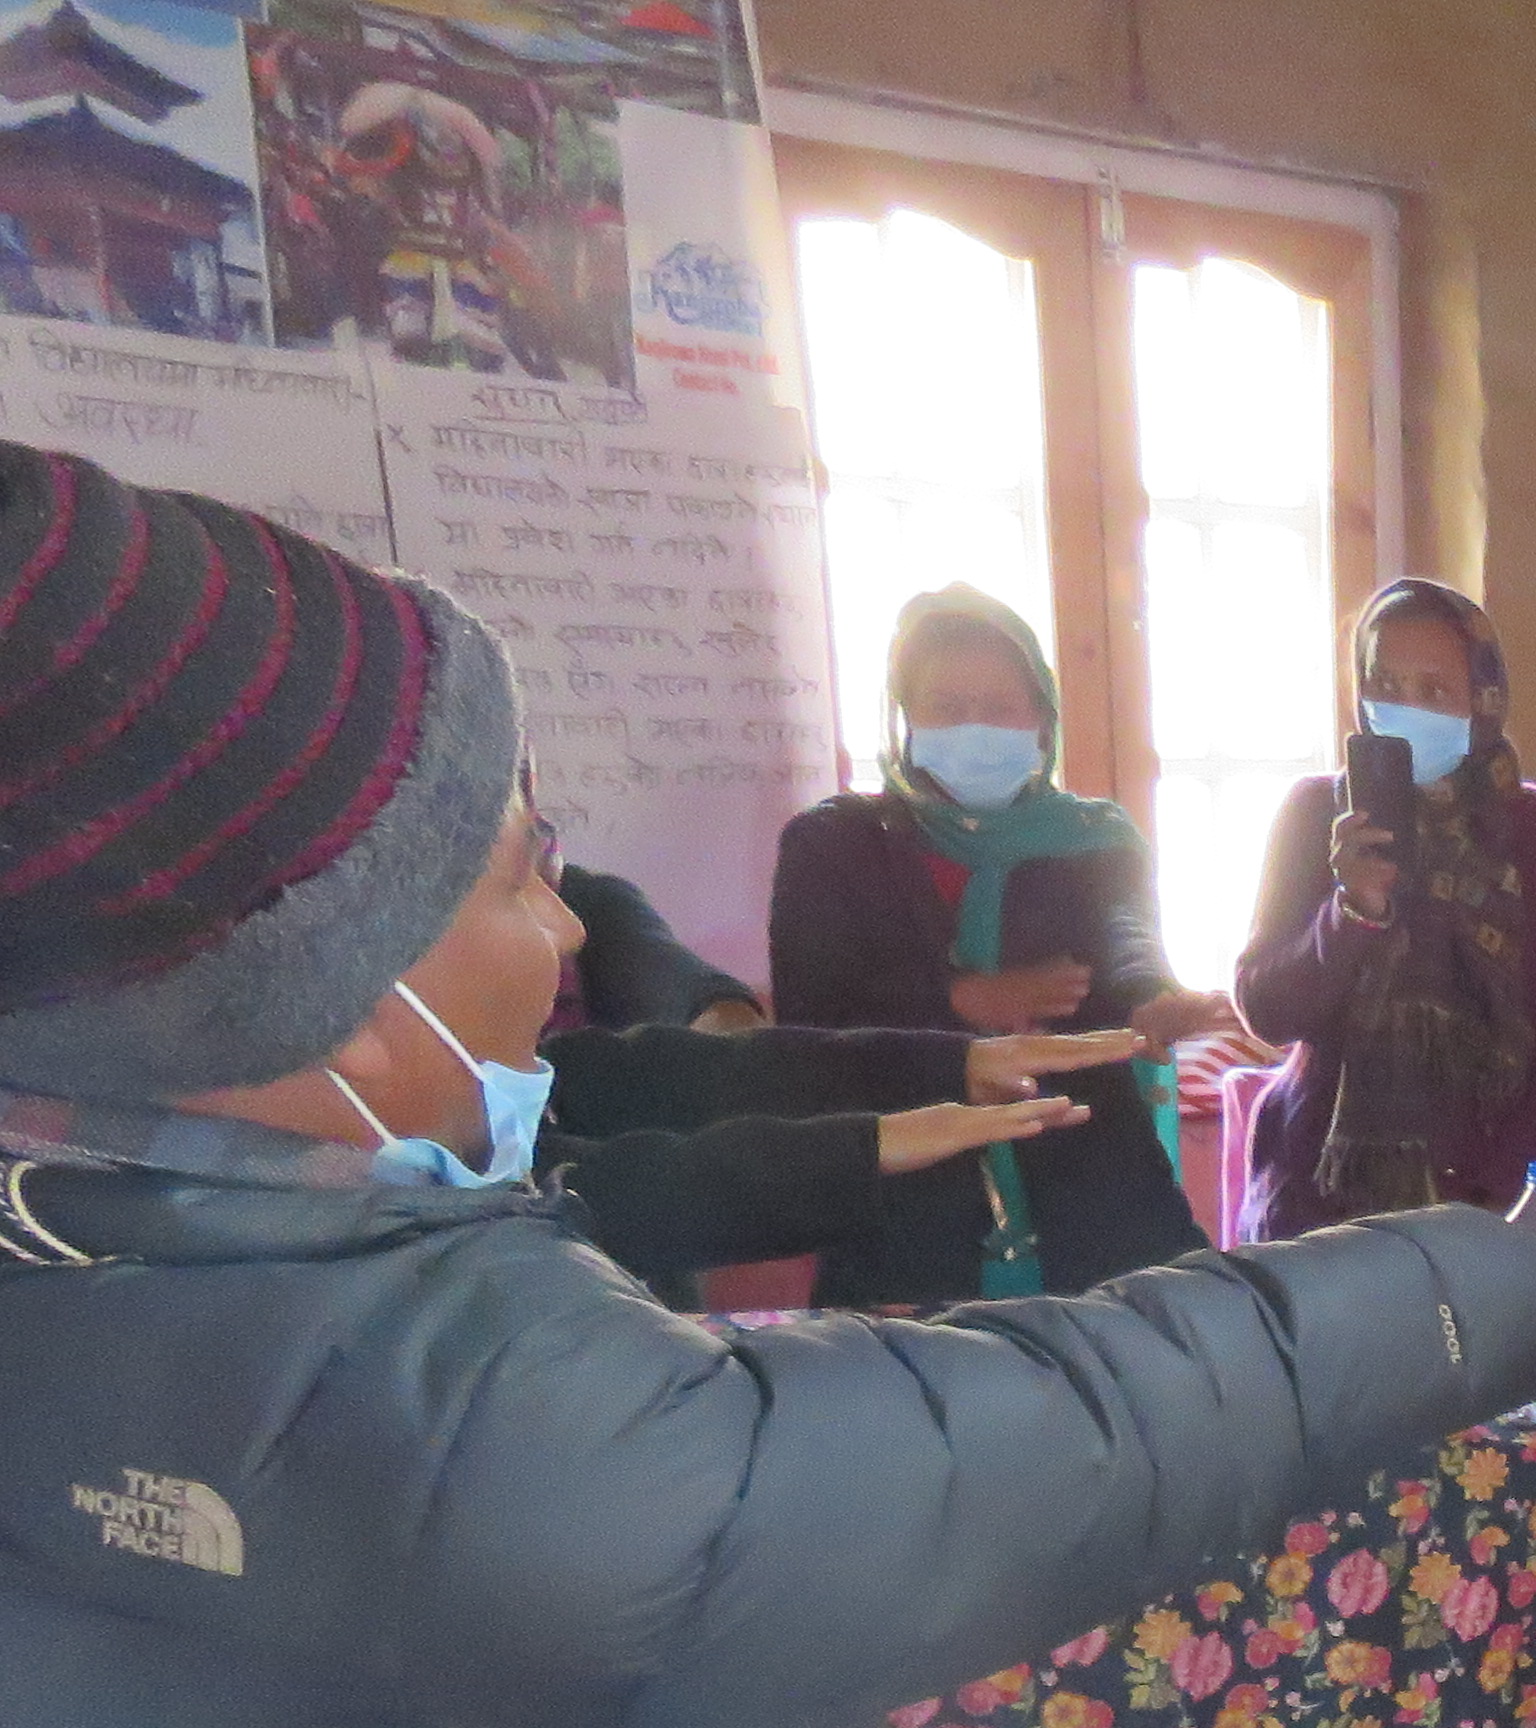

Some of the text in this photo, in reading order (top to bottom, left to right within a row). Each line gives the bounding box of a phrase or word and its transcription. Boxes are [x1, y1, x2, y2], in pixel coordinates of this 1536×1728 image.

[122, 1468, 186, 1507] THE
[70, 1484, 184, 1536] NORTH
[102, 1517, 182, 1561] FACE
